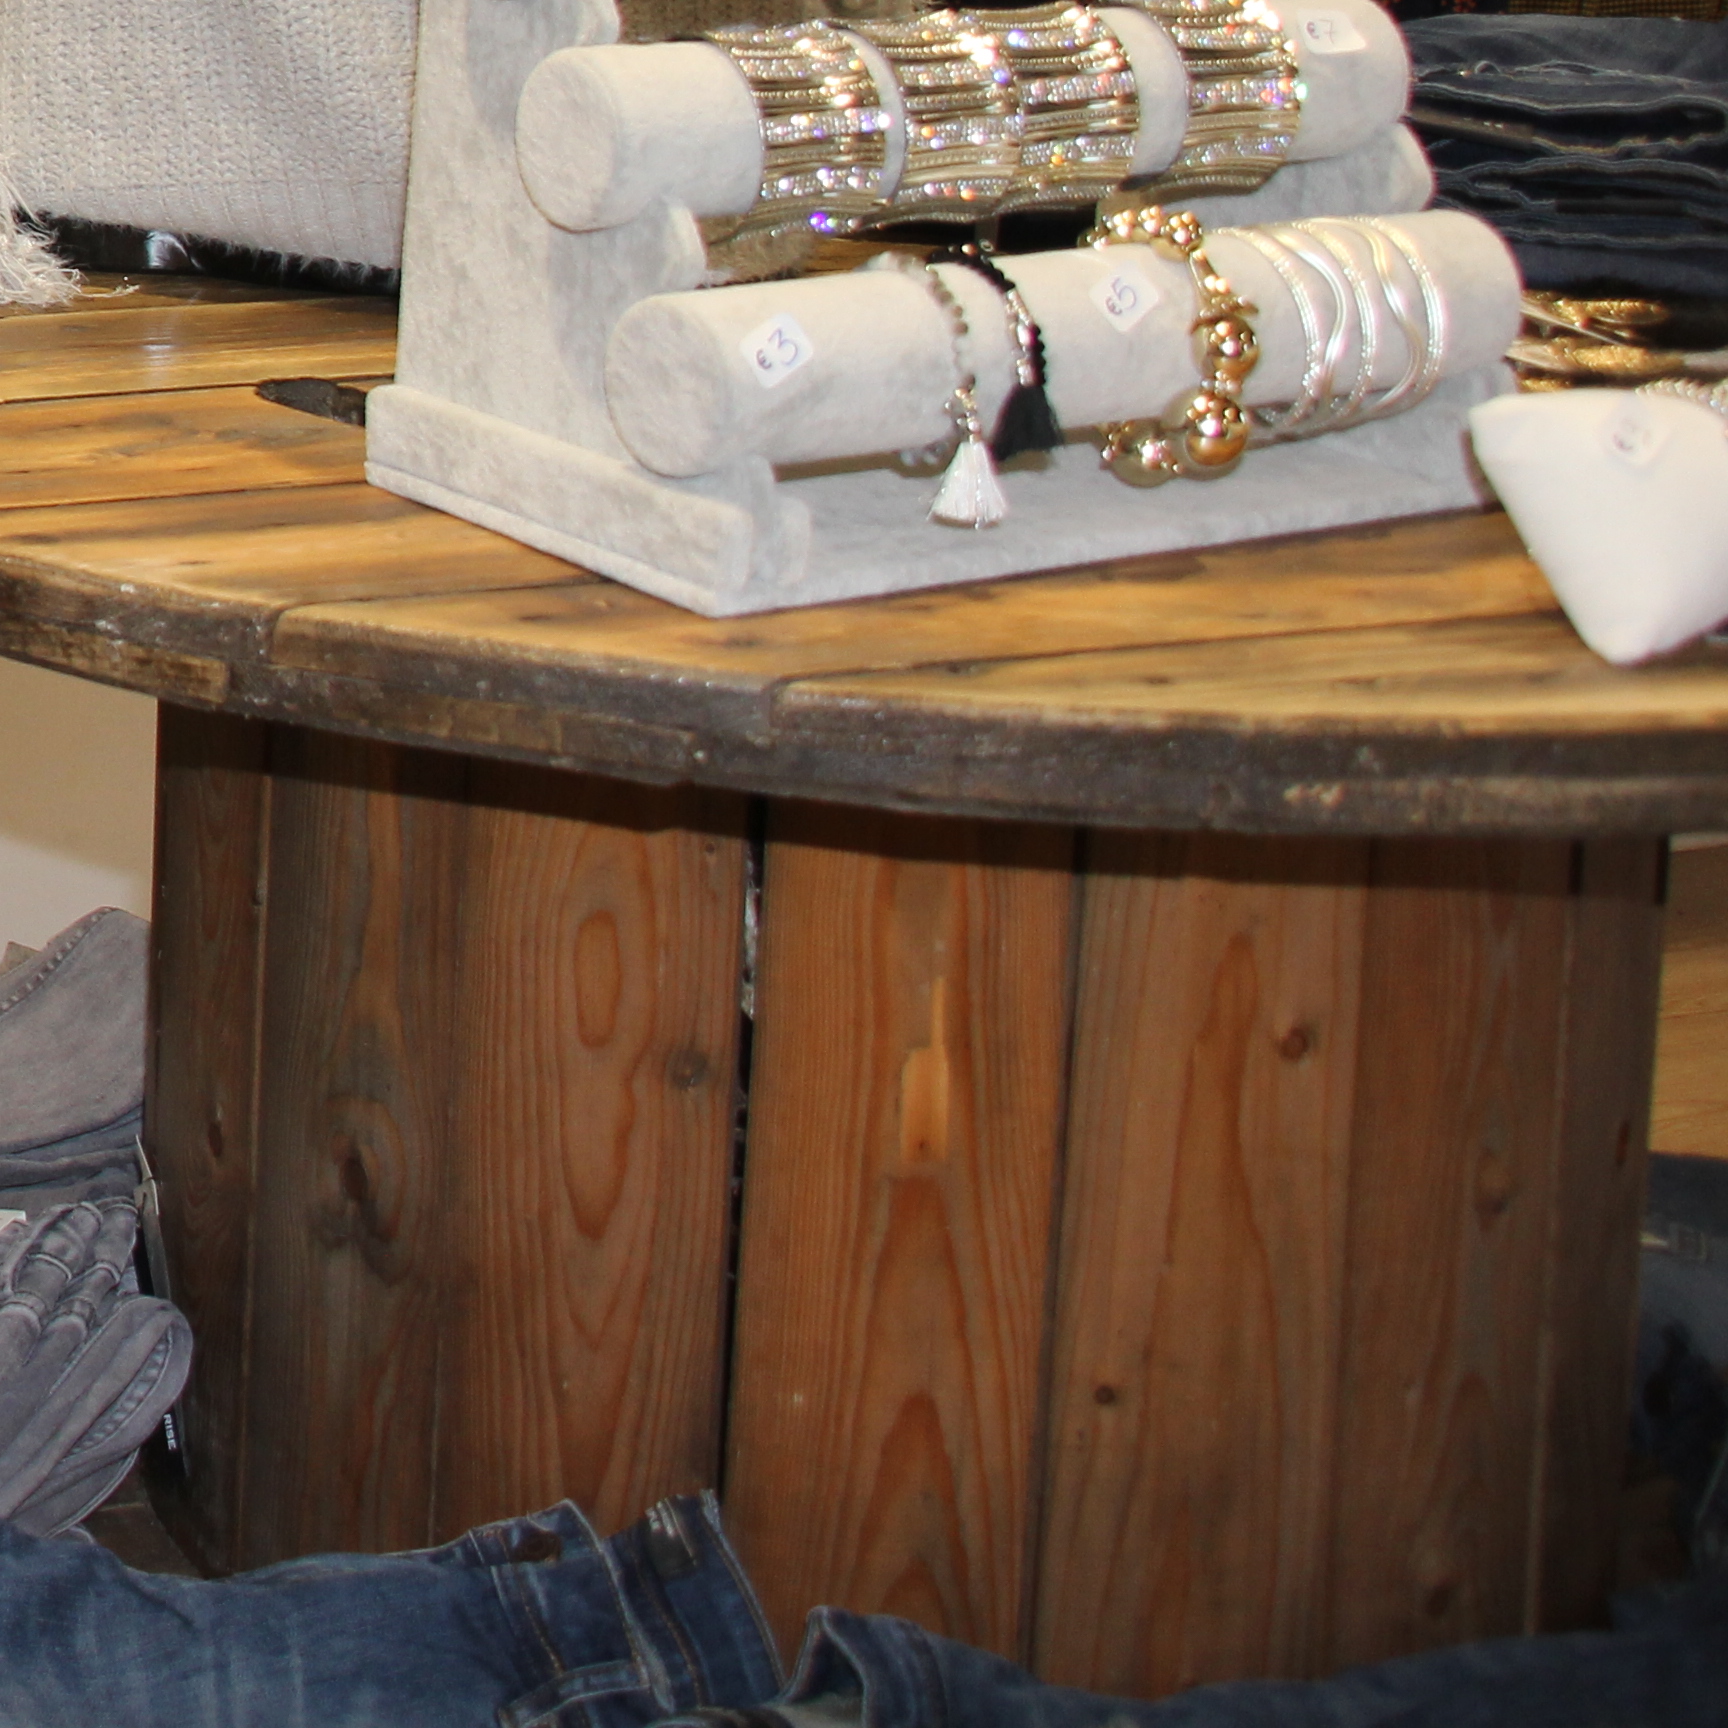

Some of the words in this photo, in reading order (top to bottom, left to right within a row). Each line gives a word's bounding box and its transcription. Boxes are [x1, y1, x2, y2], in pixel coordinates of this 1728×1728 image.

[1306, 18, 1336, 45] €7
[1105, 277, 1137, 315] €5
[756, 327, 799, 370] €3
[162, 1413, 177, 1451] RISE
